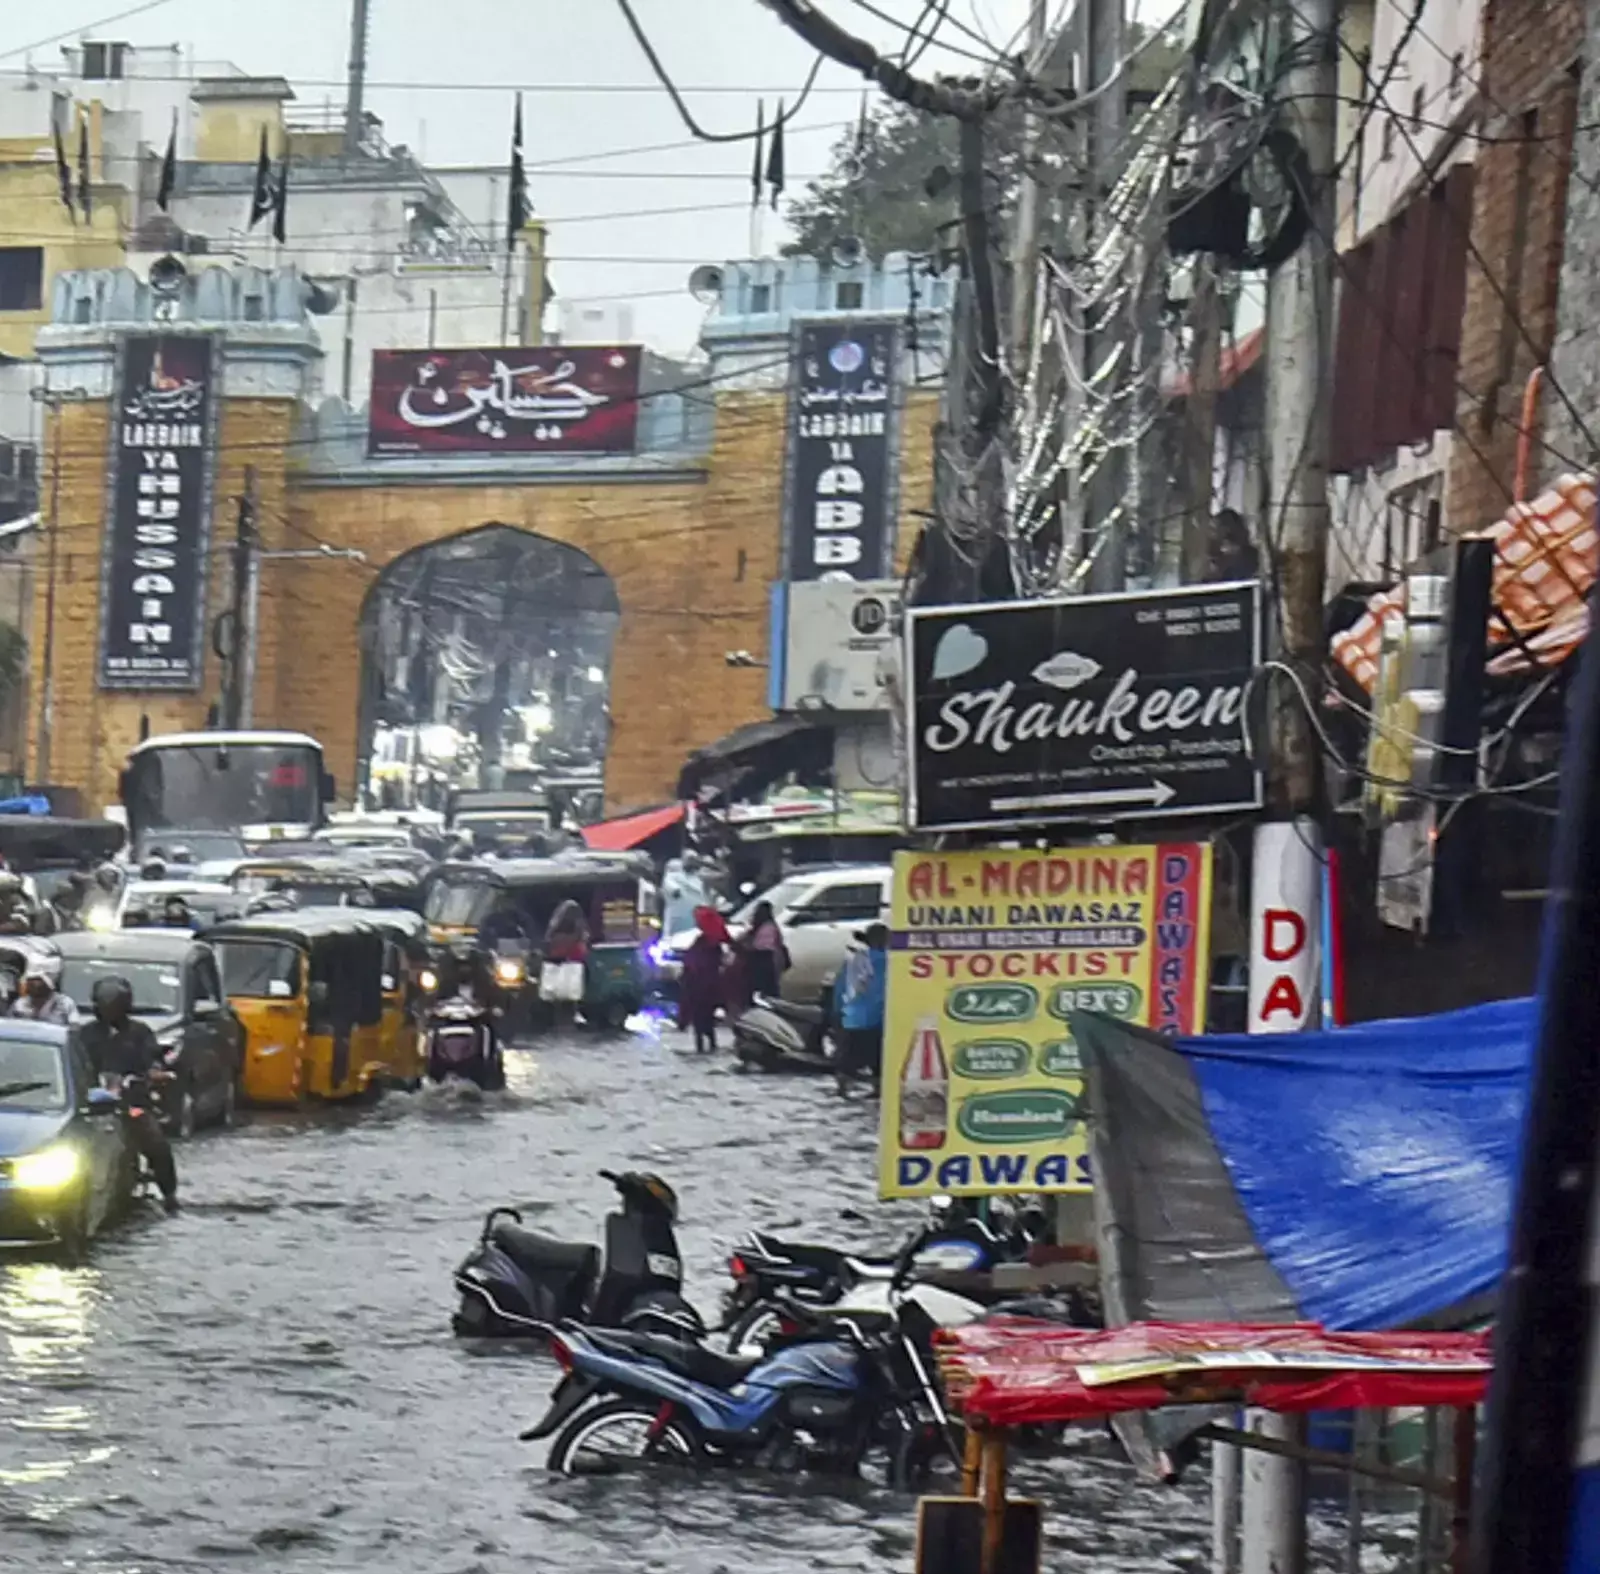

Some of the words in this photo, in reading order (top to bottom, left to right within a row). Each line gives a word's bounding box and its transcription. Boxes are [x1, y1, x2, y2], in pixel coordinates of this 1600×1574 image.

[924, 668, 1243, 752] Shaukeen
[907, 857, 1149, 901] AL-MADINA
[907, 905, 996, 926] UNANI
[1006, 902, 1142, 924] DAWASAZ
[909, 950, 1140, 979] STOCKIST
